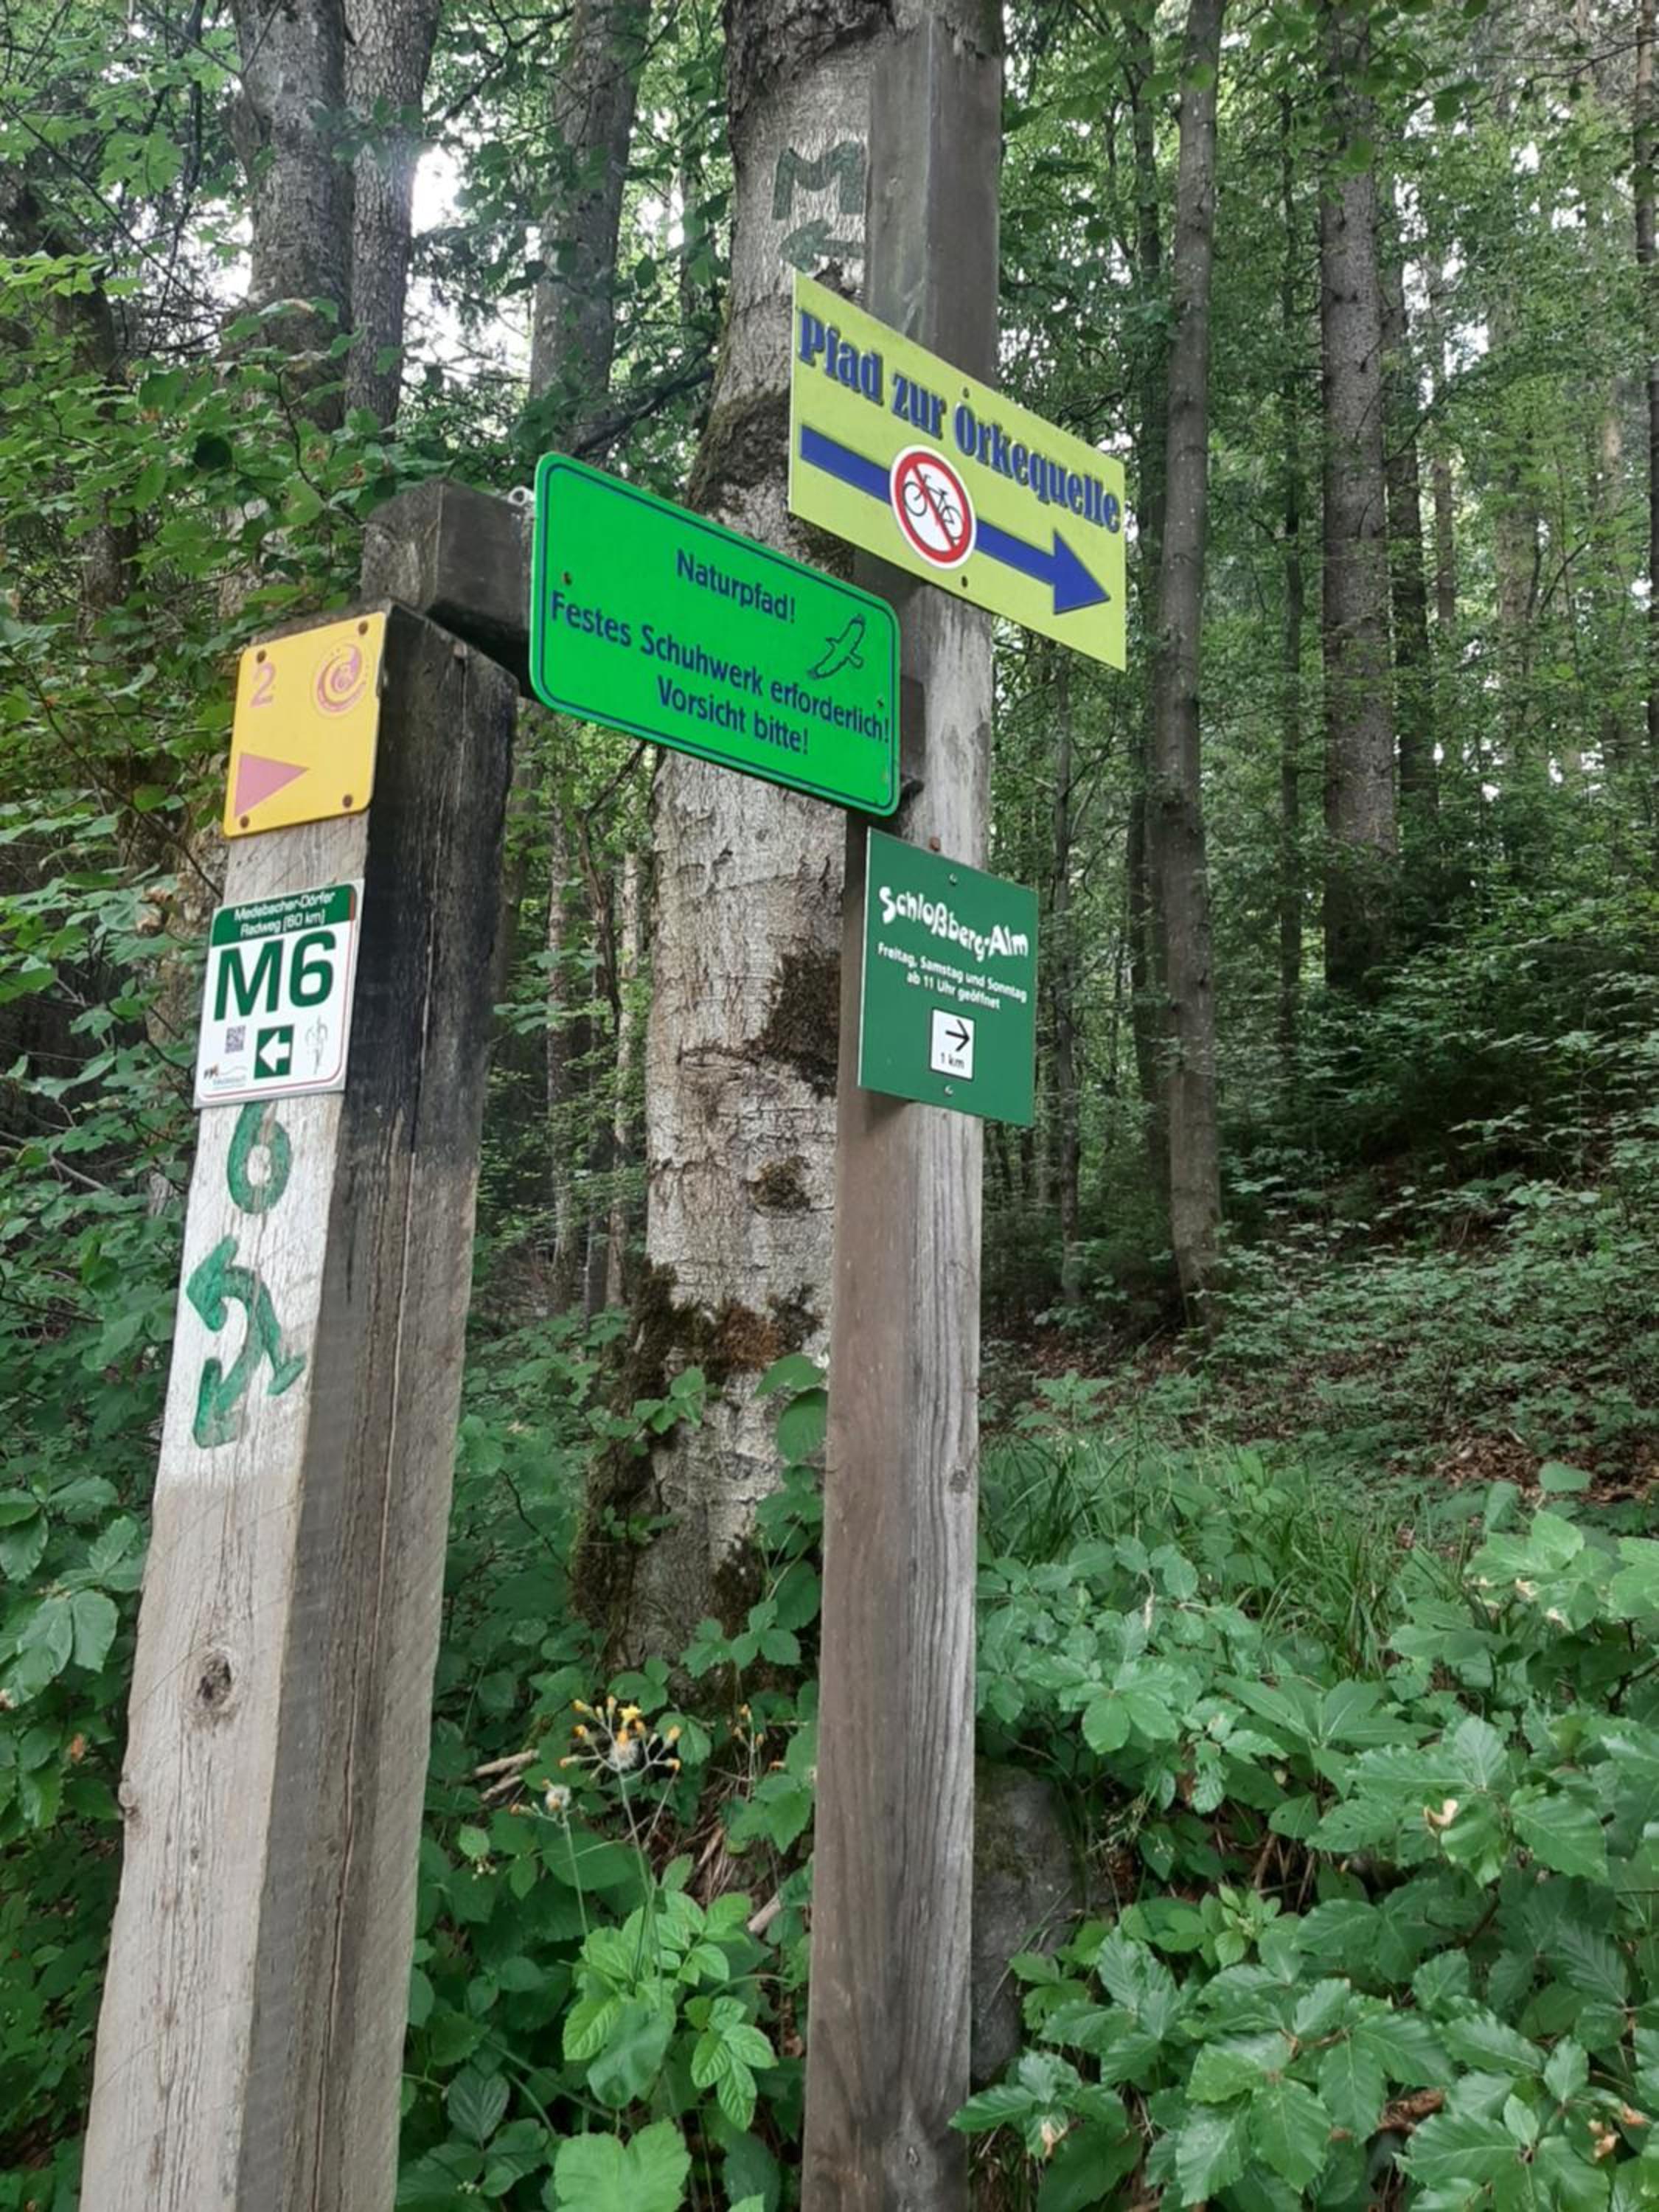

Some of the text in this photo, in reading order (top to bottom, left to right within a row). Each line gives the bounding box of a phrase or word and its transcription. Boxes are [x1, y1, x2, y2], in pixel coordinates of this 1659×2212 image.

[771, 140, 866, 220] M
[799, 307, 1121, 534] Pfad zur Orkequelle
[675, 548, 796, 624] Naturpfad!
[249, 660, 276, 709] 2
[551, 591, 889, 744] Festes Schuhwerk erforderlich!
[657, 675, 809, 755] Vorsicht bitte!
[240, 919, 282, 938] Radweg
[214, 930, 336, 1022] M6
[877, 942, 1028, 1004] Freitag, Samstag und Sonntag
[906, 970, 1001, 1009] ab 11 Uhr geöffnet
[940, 1052, 965, 1070] 1 km
